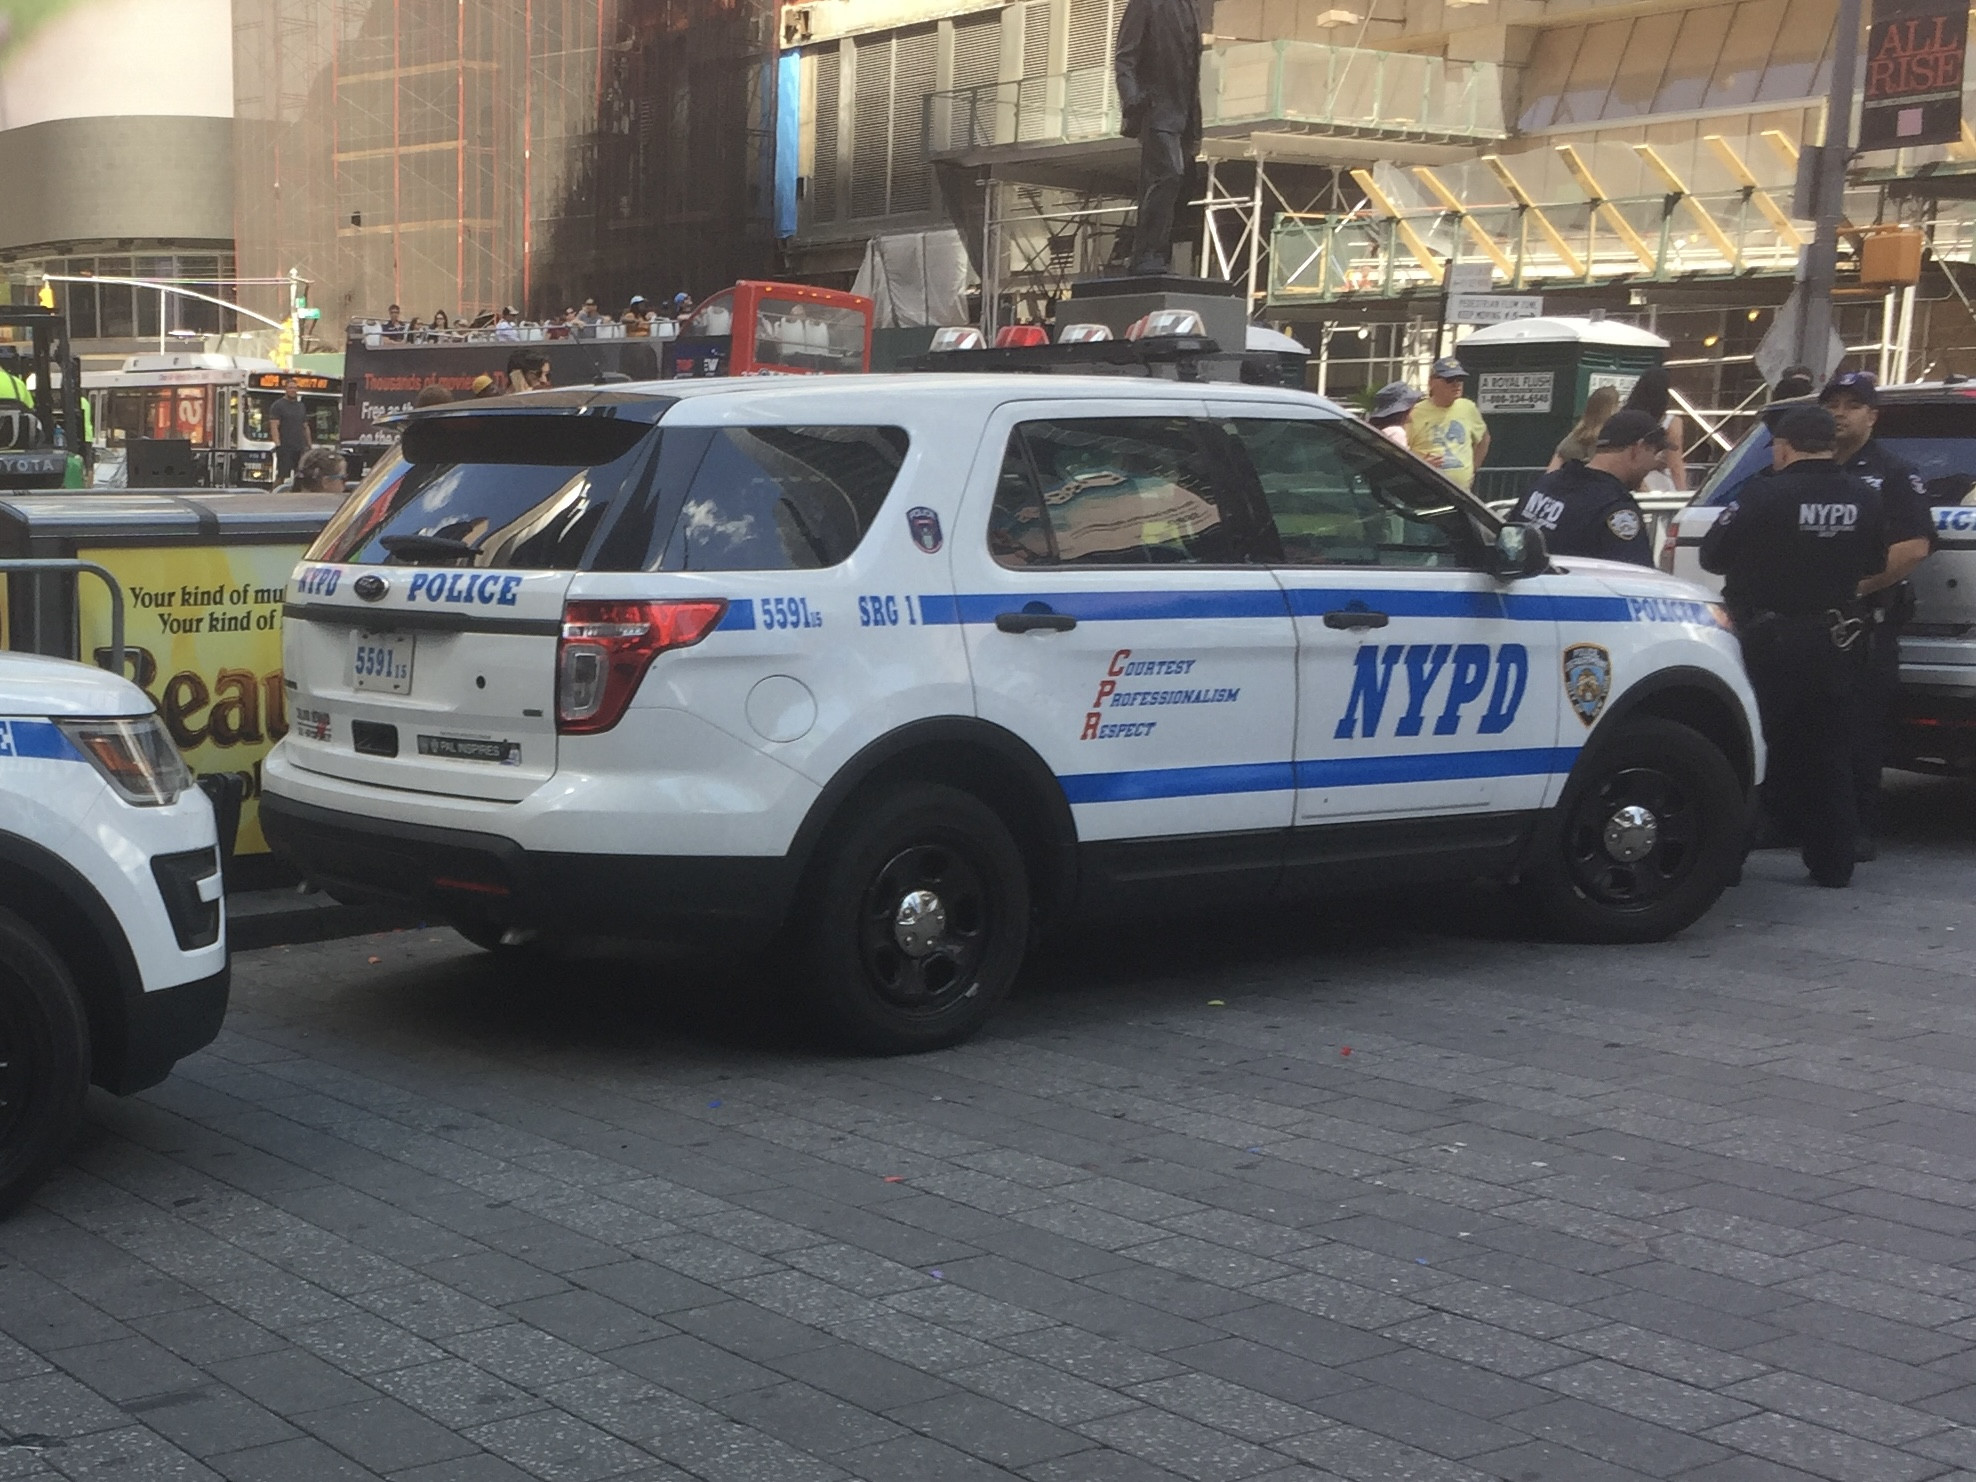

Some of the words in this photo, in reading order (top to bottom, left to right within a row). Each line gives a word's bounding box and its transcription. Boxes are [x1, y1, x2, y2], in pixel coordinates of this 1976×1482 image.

[1876, 16, 1958, 60] ALL
[1866, 49, 1963, 96] RISE
[1482, 377, 1489, 388] A
[1492, 376, 1520, 388] ROYAL
[1524, 375, 1551, 388] FLUSH
[1523, 490, 1565, 523] NYPD
[1799, 503, 1858, 526] NYPD
[130, 586, 175, 608] Your
[181, 585, 223, 606] kind
[229, 584, 250, 604] of
[298, 567, 342, 597] NYPD
[407, 573, 523, 606] POLICE
[158, 613, 202, 634] Your
[208, 611, 250, 632] kind
[256, 610, 275, 630] of
[761, 597, 811, 630] 5591
[858, 596, 899, 627] SRG
[355, 646, 393, 677] 5591
[1093, 680, 1241, 708] PROFESSIONALISM
[1333, 643, 1529, 739] NYPD
[1080, 712, 1157, 740] RESPECT
